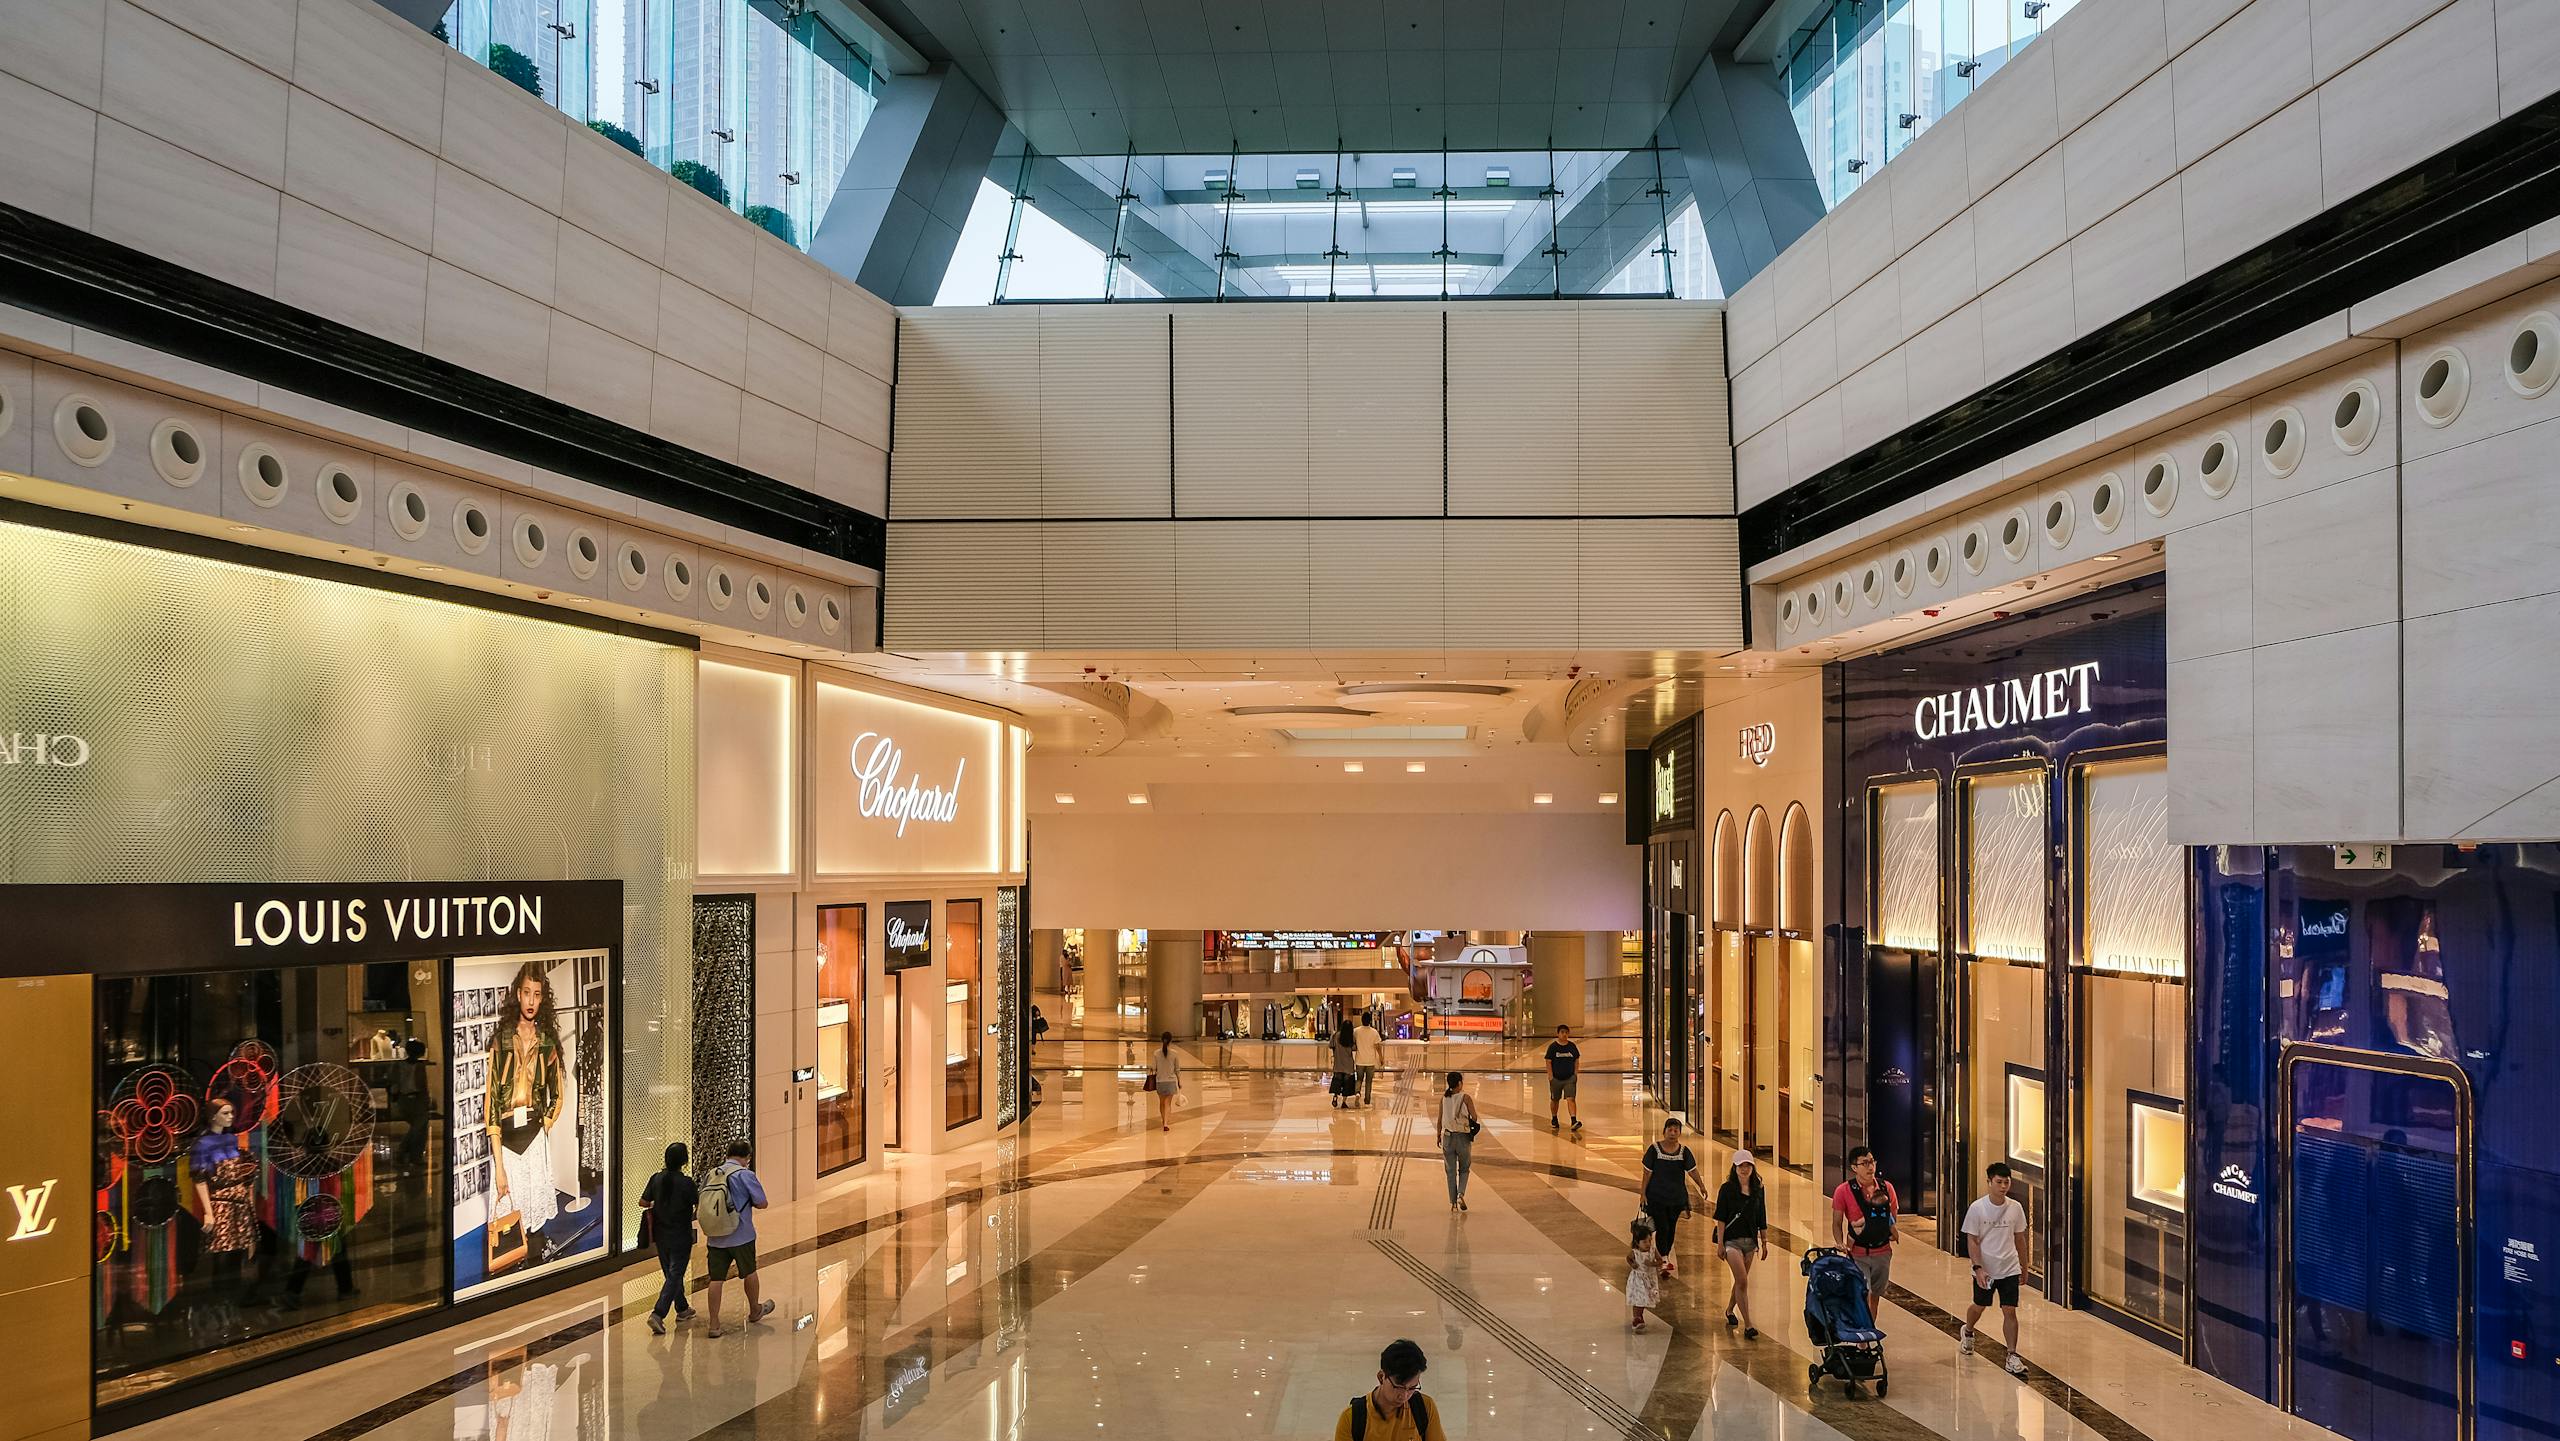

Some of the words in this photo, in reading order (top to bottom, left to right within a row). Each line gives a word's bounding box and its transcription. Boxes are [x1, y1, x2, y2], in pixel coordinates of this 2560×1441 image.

[1914, 661, 2100, 740] CHAUMET
[1739, 722, 1776, 768] FRED
[851, 732, 966, 839] Chopard
[234, 898, 368, 947] LOUIS
[383, 894, 542, 942] VUITTON
[887, 917, 929, 954] Chopard
[5, 1178, 58, 1242] LV
[2213, 1182, 2258, 1205] CHAUMET
